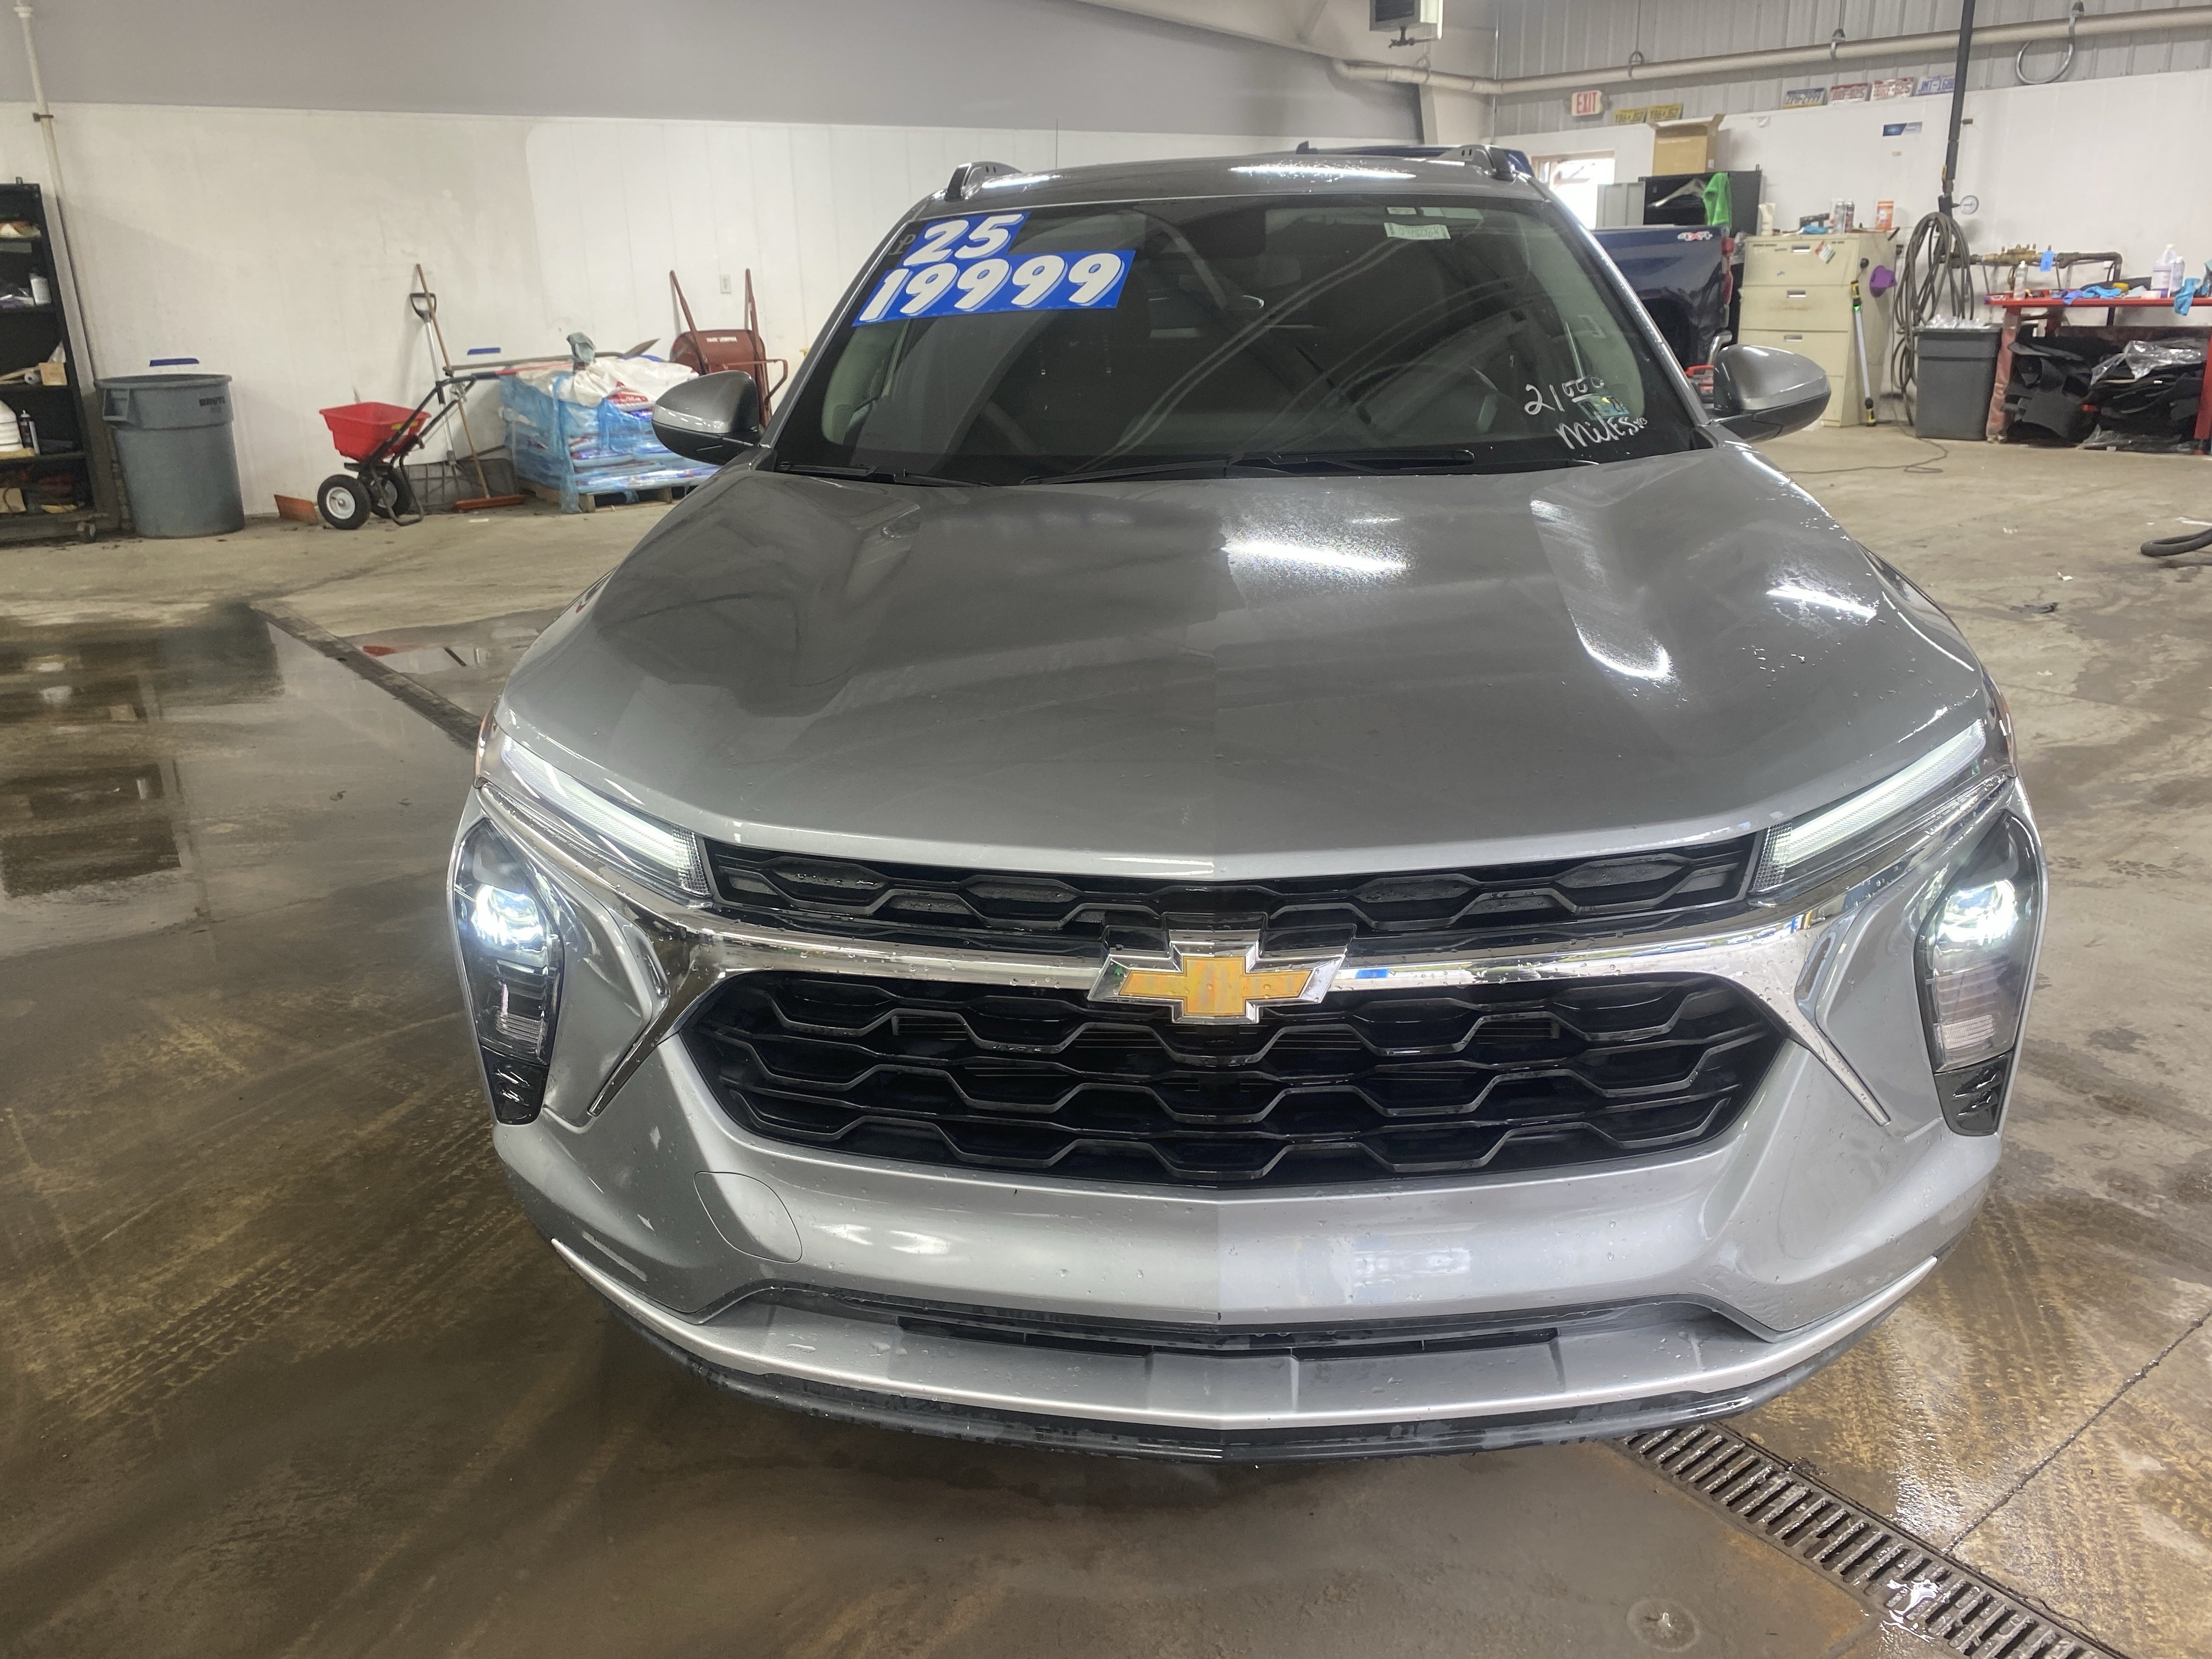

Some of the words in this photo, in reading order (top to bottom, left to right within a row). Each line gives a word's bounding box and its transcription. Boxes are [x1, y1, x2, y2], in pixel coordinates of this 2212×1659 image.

[1576, 91, 1598, 114] EXIT
[903, 213, 1025, 267] 25
[859, 253, 1125, 323] 19999
